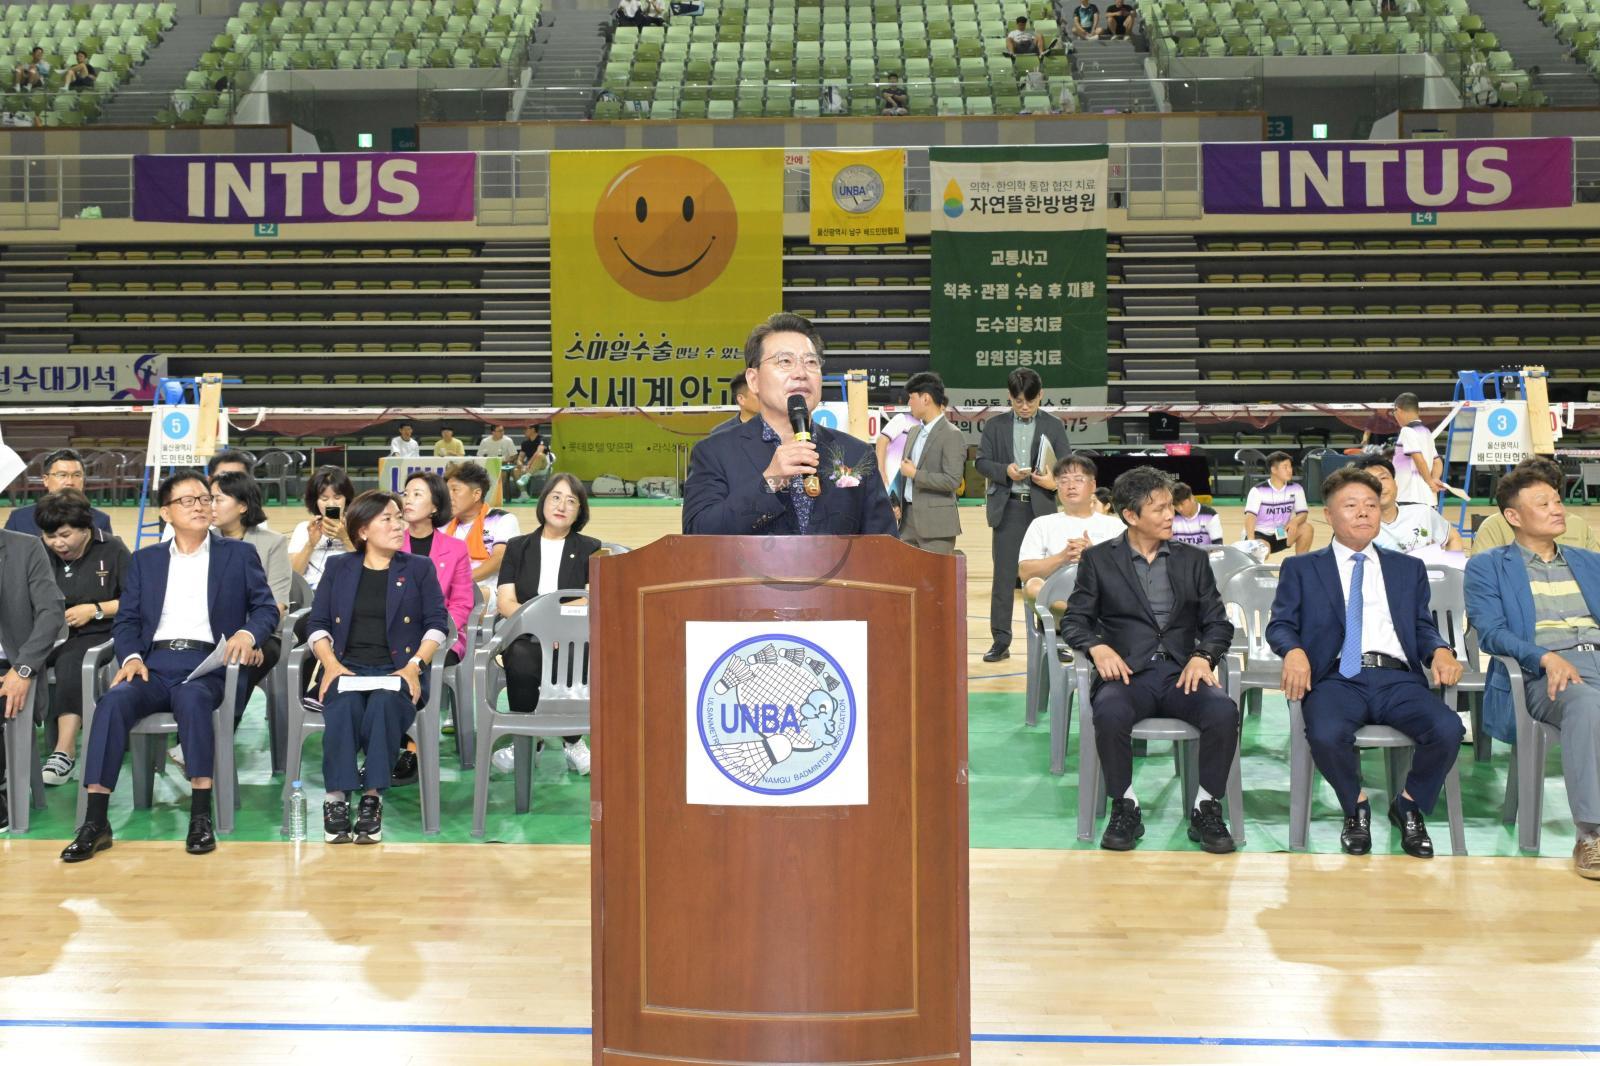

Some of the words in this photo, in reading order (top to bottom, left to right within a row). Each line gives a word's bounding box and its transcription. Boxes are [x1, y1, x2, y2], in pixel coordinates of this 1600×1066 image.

[1029, 179, 1049, 192] 통합
[1075, 178, 1096, 191] 치료
[1261, 146, 1513, 208] INTUS
[187, 158, 421, 219] INTUS
[839, 185, 866, 196] UNBA
[969, 193, 1096, 215] 자연뜰한방병원
[1416, 213, 1433, 223] E4
[258, 222, 275, 234] E2
[990, 250, 1049, 266] 교통사고
[943, 283, 1010, 300] 척추·관절
[1014, 283, 1043, 299] 수술
[1047, 283, 1063, 299] 후
[1067, 281, 1096, 298] 재활
[975, 316, 1063, 333] 도수집중치료
[564, 339, 673, 361] 스마일수술
[703, 347, 718, 359] 수
[975, 349, 1063, 367] 입원집중치료
[879, 375, 890, 387] 25
[171, 418, 181, 434] 5
[868, 416, 877, 437] 0
[1496, 414, 1508, 431] 3
[1487, 441, 1520, 450] 울산광역시
[153, 453, 201, 464] 드민턴협회
[1266, 506, 1293, 515] INTUS
[720, 703, 801, 733] UNBA
[762, 775, 791, 784] NAMGU
[793, 752, 833, 781] BADMINTON
[832, 698, 846, 750] ASSOCIATION
